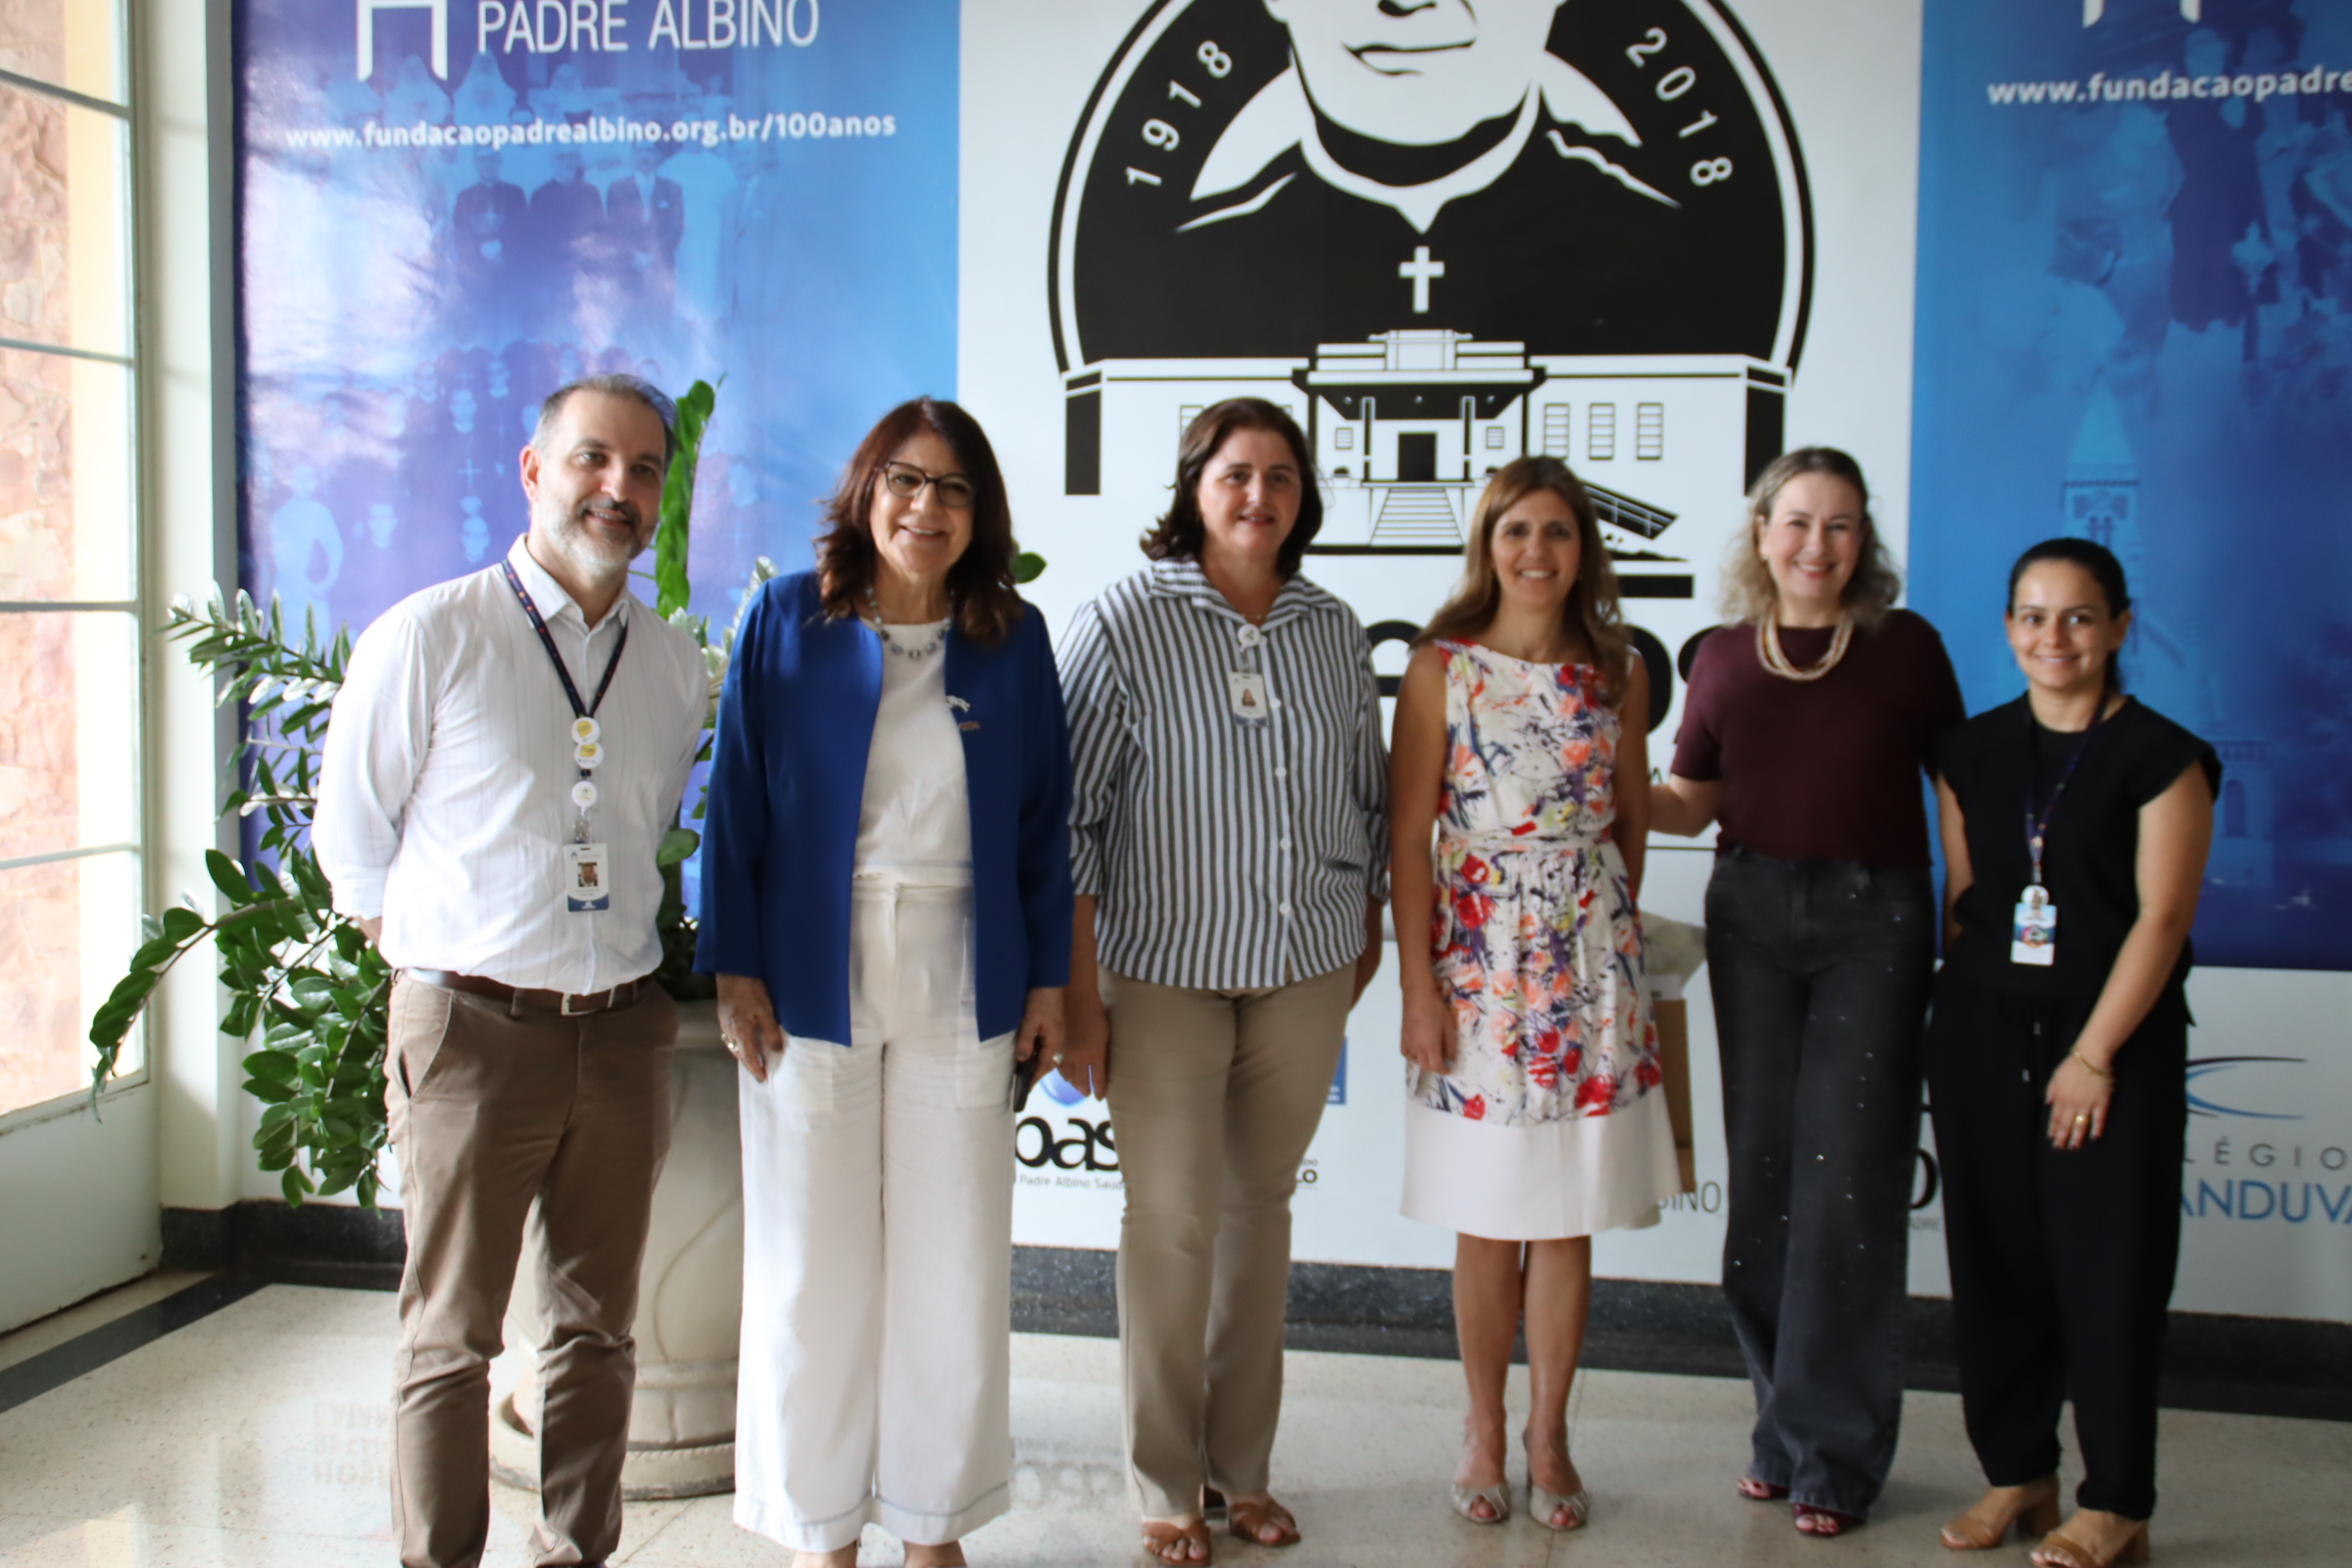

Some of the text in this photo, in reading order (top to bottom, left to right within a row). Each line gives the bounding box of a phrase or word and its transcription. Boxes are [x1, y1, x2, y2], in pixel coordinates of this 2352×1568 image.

[478, 0, 820, 54] PADRE ALBINO
[285, 113, 898, 150] www.fundacaopadrealbino.org.br/100anos
[1126, 40, 1233, 186] 1918
[1626, 27, 1734, 186] 2018
[1020, 1175, 1051, 1187] Padre
[1055, 1177, 1091, 1189] Albino
